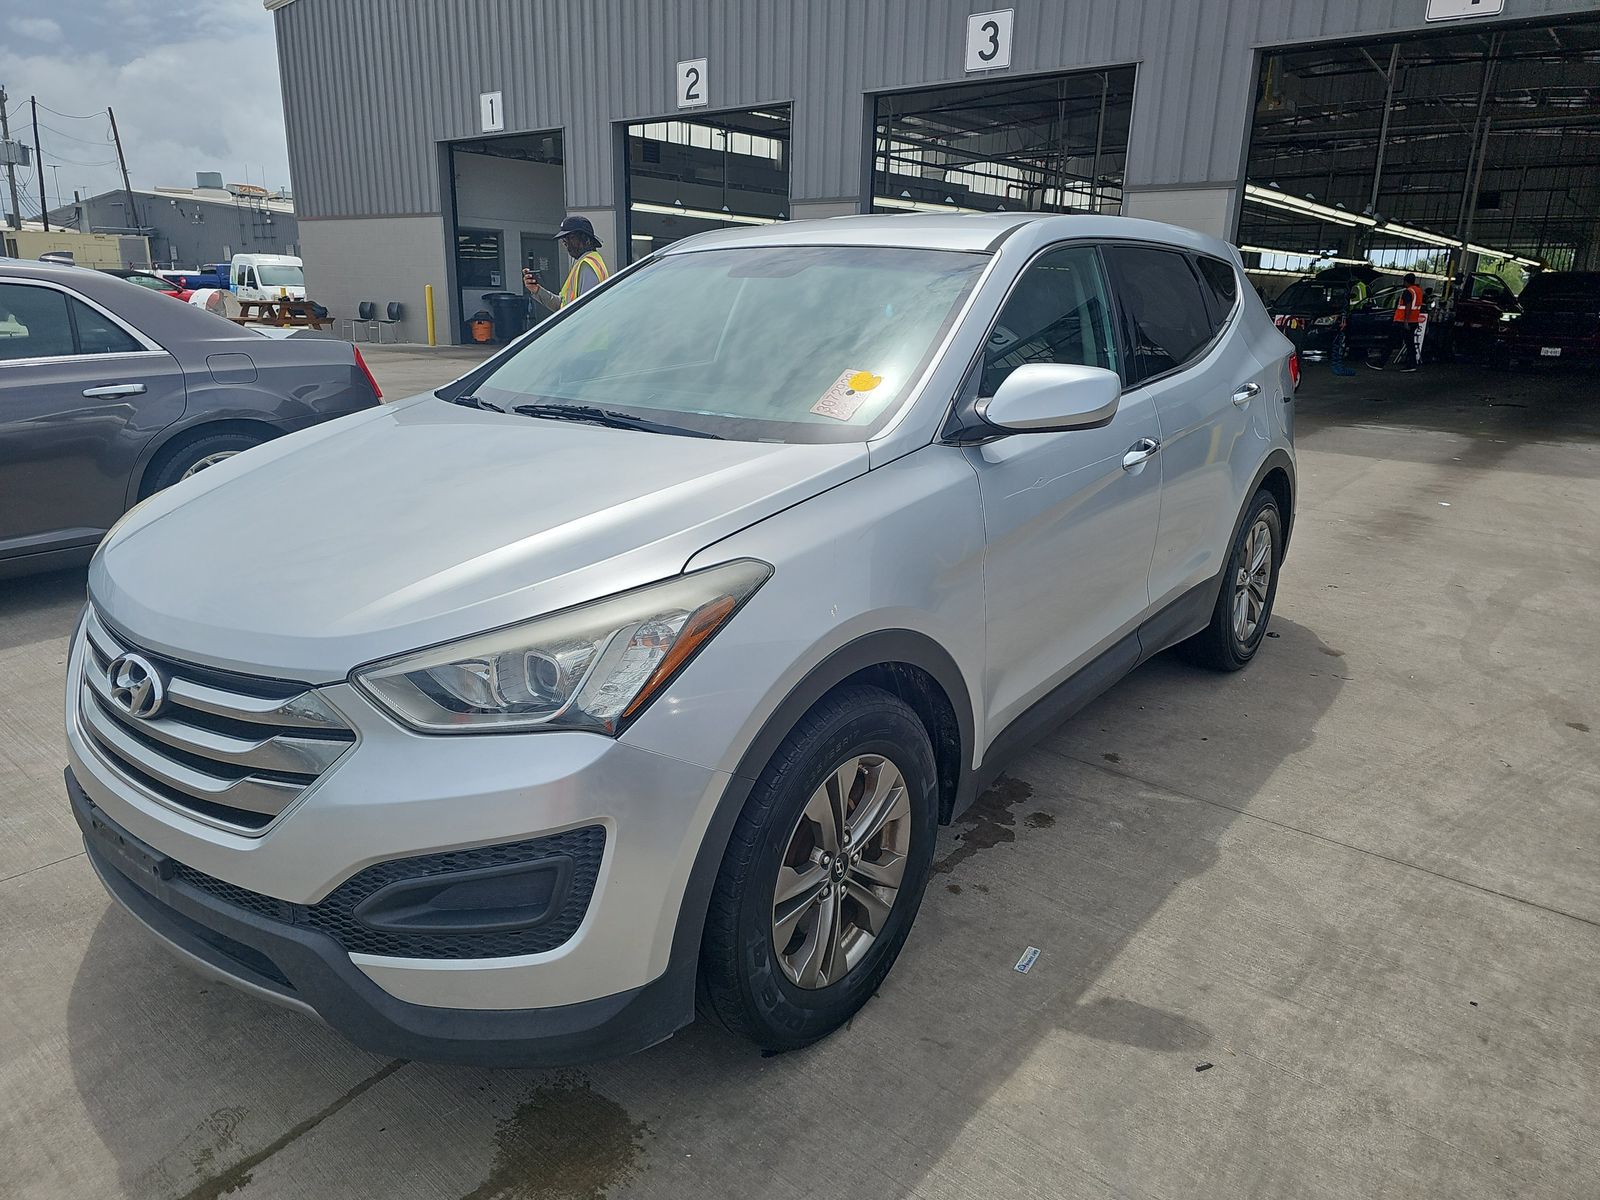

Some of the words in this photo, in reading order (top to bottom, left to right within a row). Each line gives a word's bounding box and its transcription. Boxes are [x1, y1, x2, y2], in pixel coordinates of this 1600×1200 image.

[978, 21, 999, 61] 3
[686, 67, 700, 101] 2
[489, 98, 495, 126] 1
